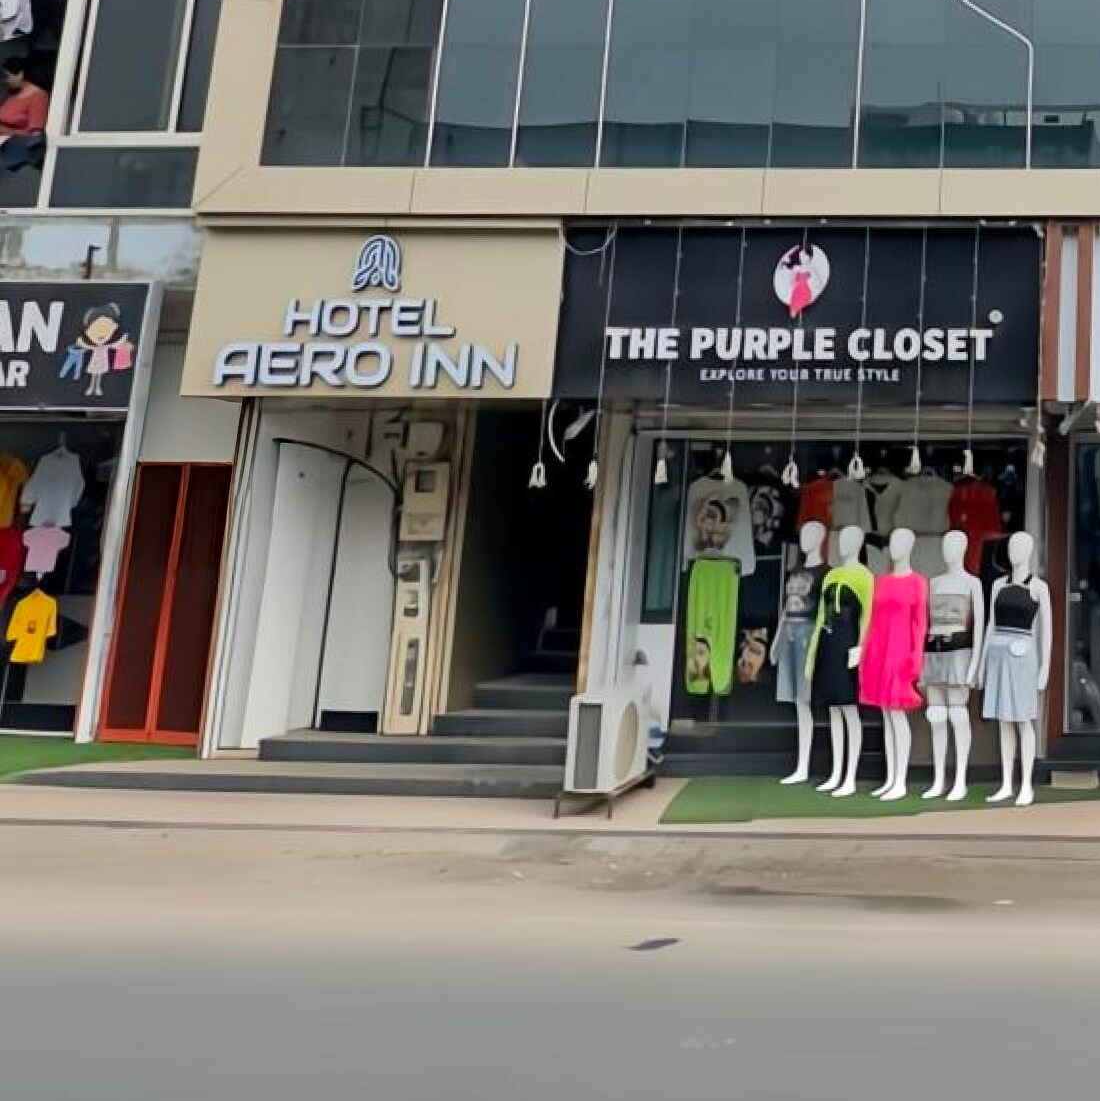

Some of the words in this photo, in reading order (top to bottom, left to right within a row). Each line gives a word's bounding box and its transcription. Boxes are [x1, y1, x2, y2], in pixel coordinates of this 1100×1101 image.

[283, 298, 457, 338] HOTEL
[605, 326, 682, 361] THE
[689, 326, 836, 362] PURPLE
[847, 327, 994, 362] CLOSET
[0, 358, 30, 388] R
[212, 342, 393, 389] AERO
[408, 341, 518, 390] INN
[699, 368, 765, 381] EXPLORE
[769, 368, 809, 381] YOUR
[813, 368, 853, 381] TRUE
[857, 368, 900, 382] STYLE
